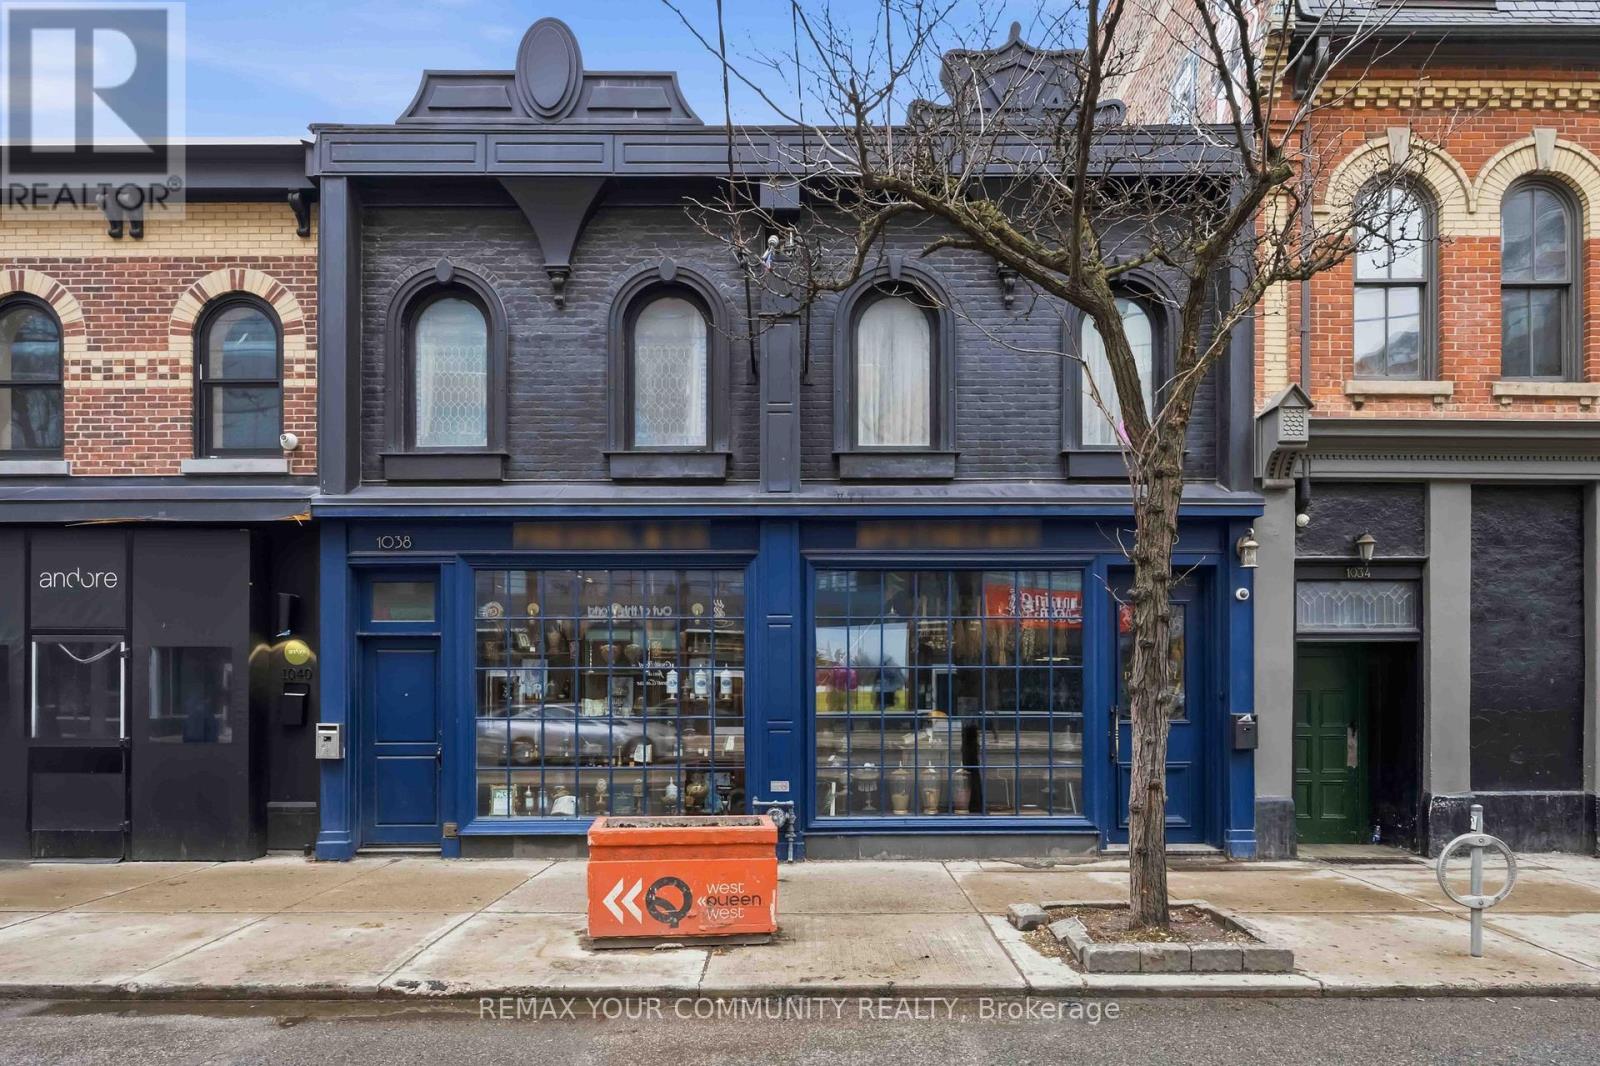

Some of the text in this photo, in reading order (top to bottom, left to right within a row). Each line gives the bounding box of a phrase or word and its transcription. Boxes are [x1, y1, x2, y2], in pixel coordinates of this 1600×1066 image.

[376, 535, 412, 549] 1038
[39, 566, 118, 588] andore
[1346, 567, 1371, 578] 1034
[281, 667, 313, 681] 1040
[706, 882, 745, 895] west
[706, 907, 745, 920] west
